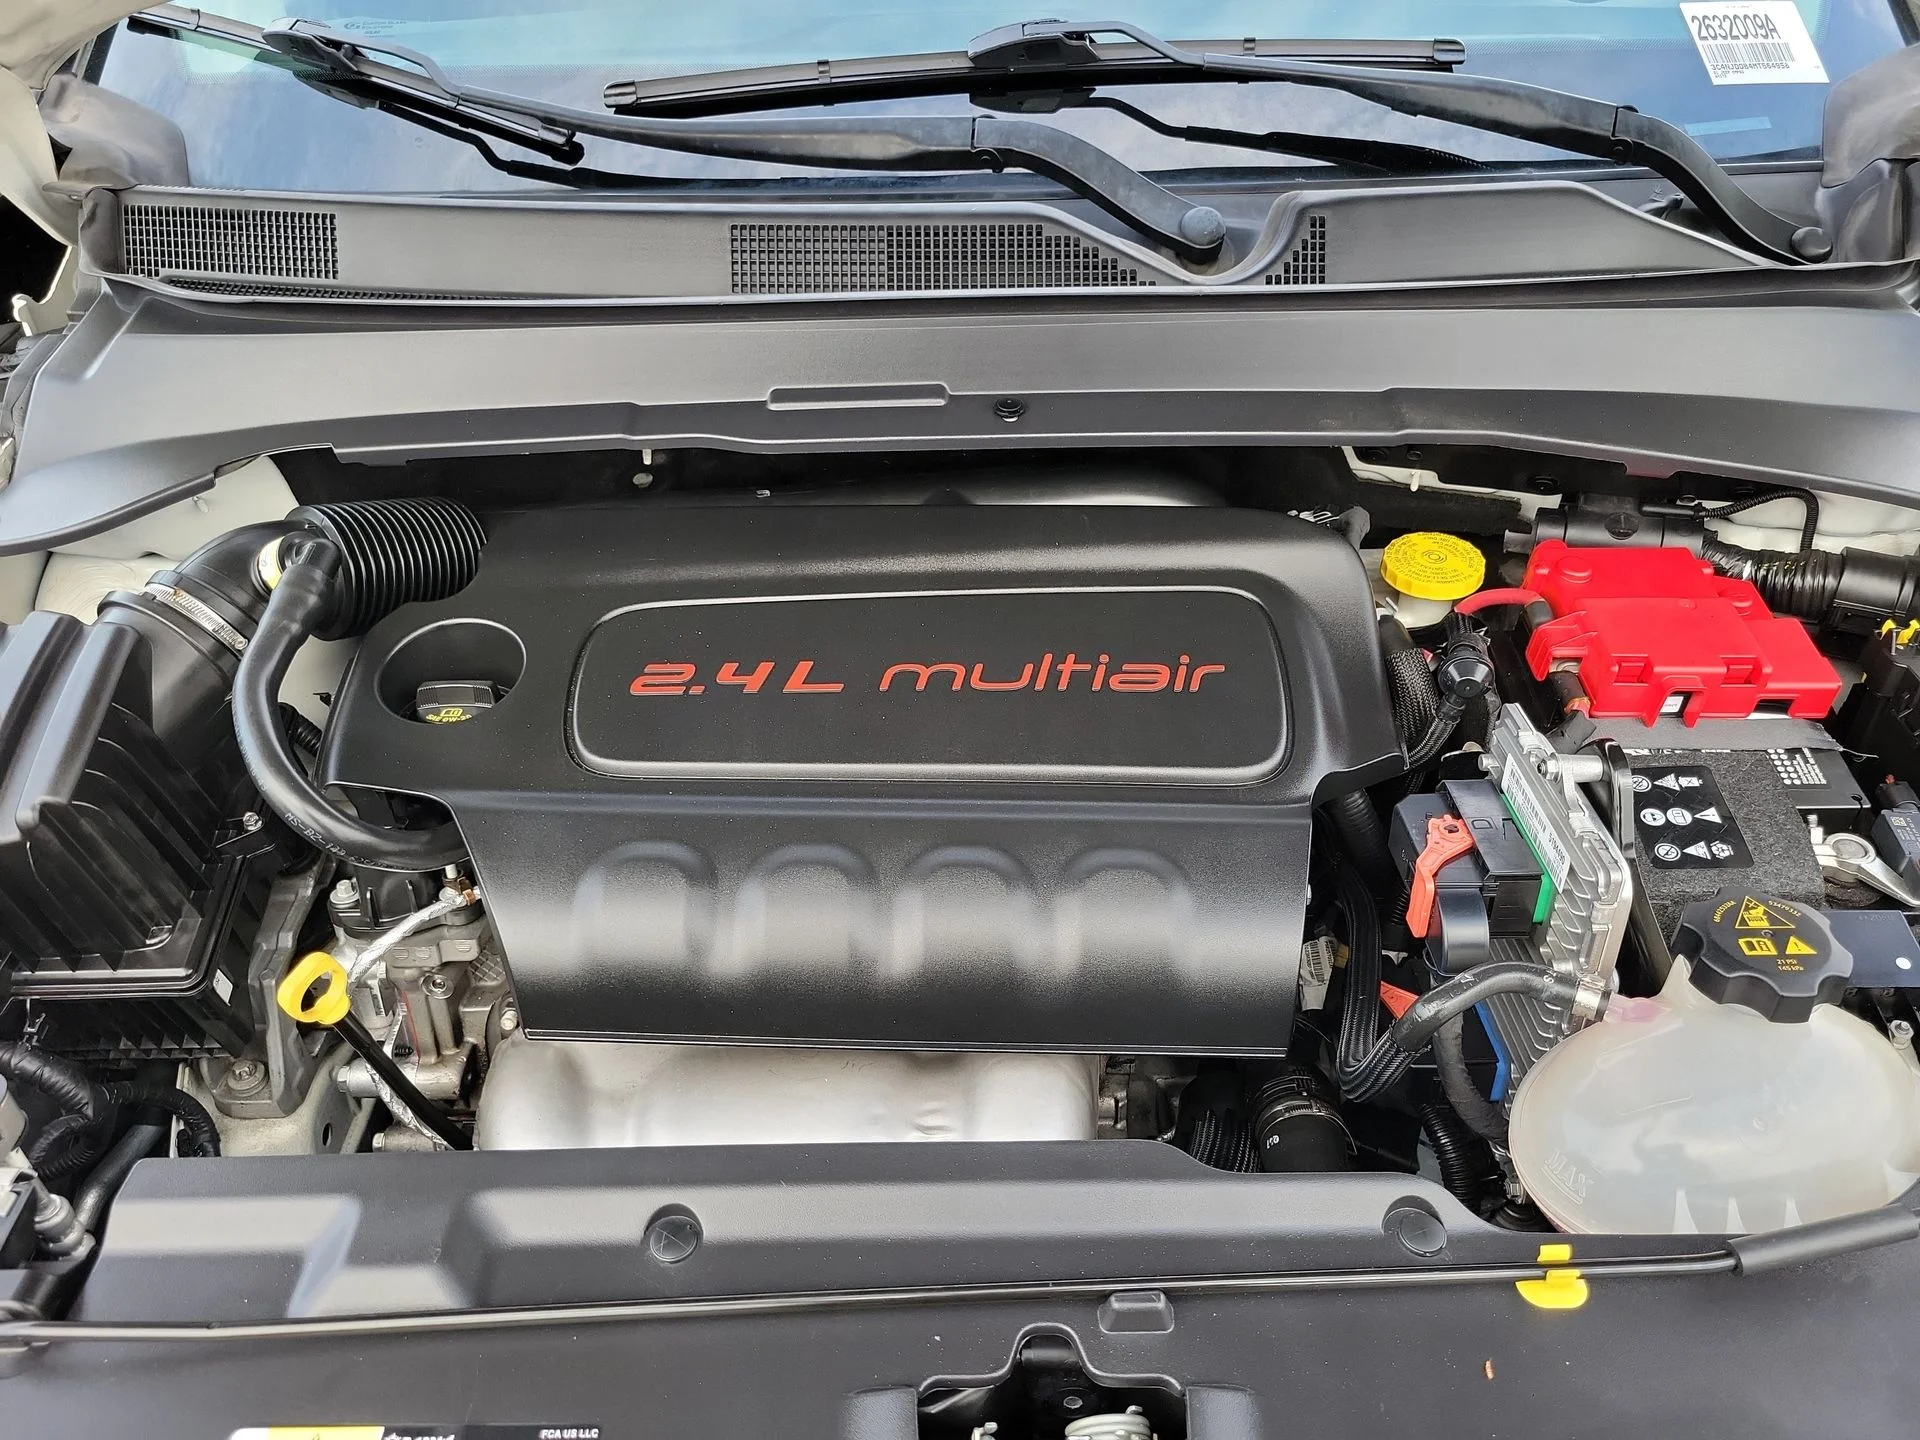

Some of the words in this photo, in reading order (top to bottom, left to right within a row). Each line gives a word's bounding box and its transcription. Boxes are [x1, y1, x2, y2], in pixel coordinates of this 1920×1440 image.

[1691, 14, 1781, 41] 2632009A
[879, 653, 1225, 693] multiair
[1544, 1149, 1590, 1198] MAX
[539, 1428, 561, 1439] FCA
[562, 1427, 577, 1438] US
[578, 1427, 599, 1438] LLC
